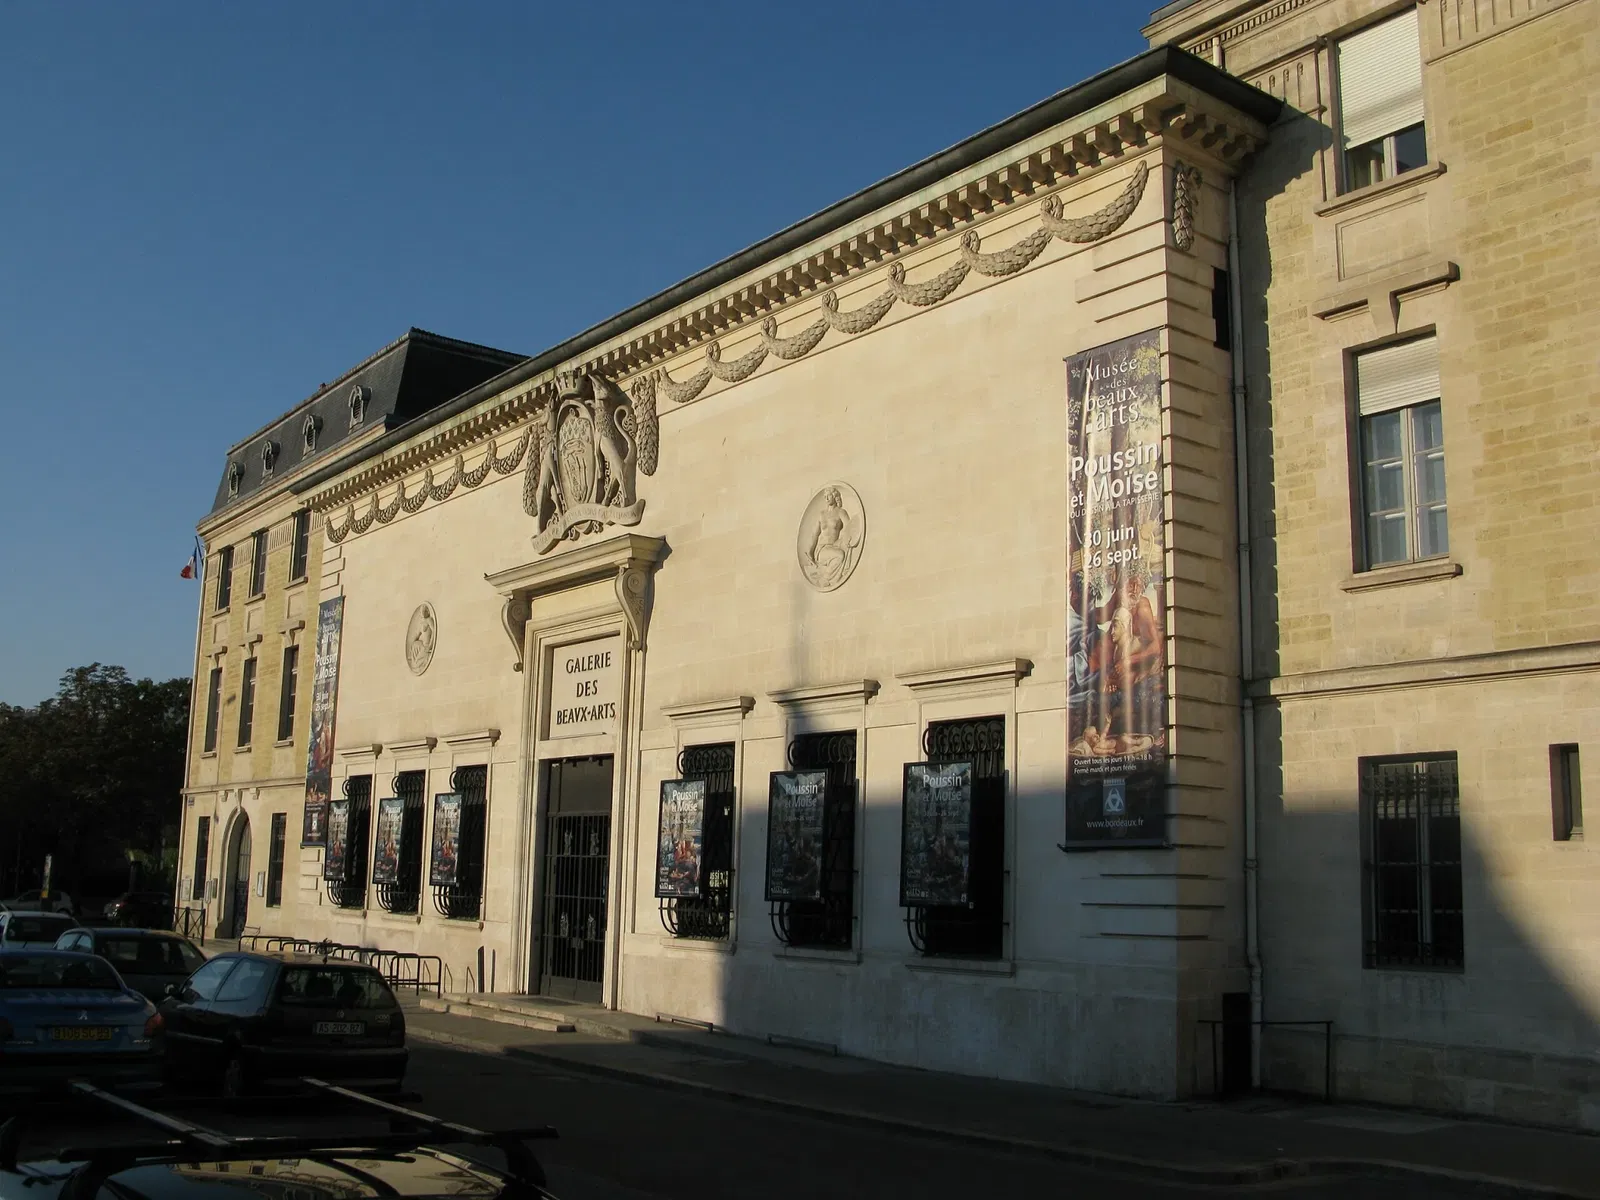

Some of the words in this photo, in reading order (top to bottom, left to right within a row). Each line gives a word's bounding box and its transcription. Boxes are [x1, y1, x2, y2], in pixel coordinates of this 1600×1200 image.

[1086, 357, 1138, 382] Musée
[1110, 379, 1127, 389] des
[1087, 386, 1138, 412] beaux
[1097, 402, 1140, 431] arts
[1071, 441, 1158, 481] Poussin
[1070, 491, 1084, 508] et
[1089, 470, 1158, 503] Moïse
[1085, 530, 1102, 549] 30
[1106, 525, 1135, 549] juin
[1087, 550, 1103, 569] 26
[1107, 544, 1142, 568] sept.
[566, 651, 612, 674] GALERIE
[576, 680, 598, 698] DES
[1073, 758, 1091, 766] Ouvert
[1110, 755, 1122, 764] jours
[784, 781, 818, 795] Poussin
[923, 773, 962, 788] Poussin
[672, 789, 698, 802] Poussin
[1086, 817, 1144, 828] www.bordeaux.fr
